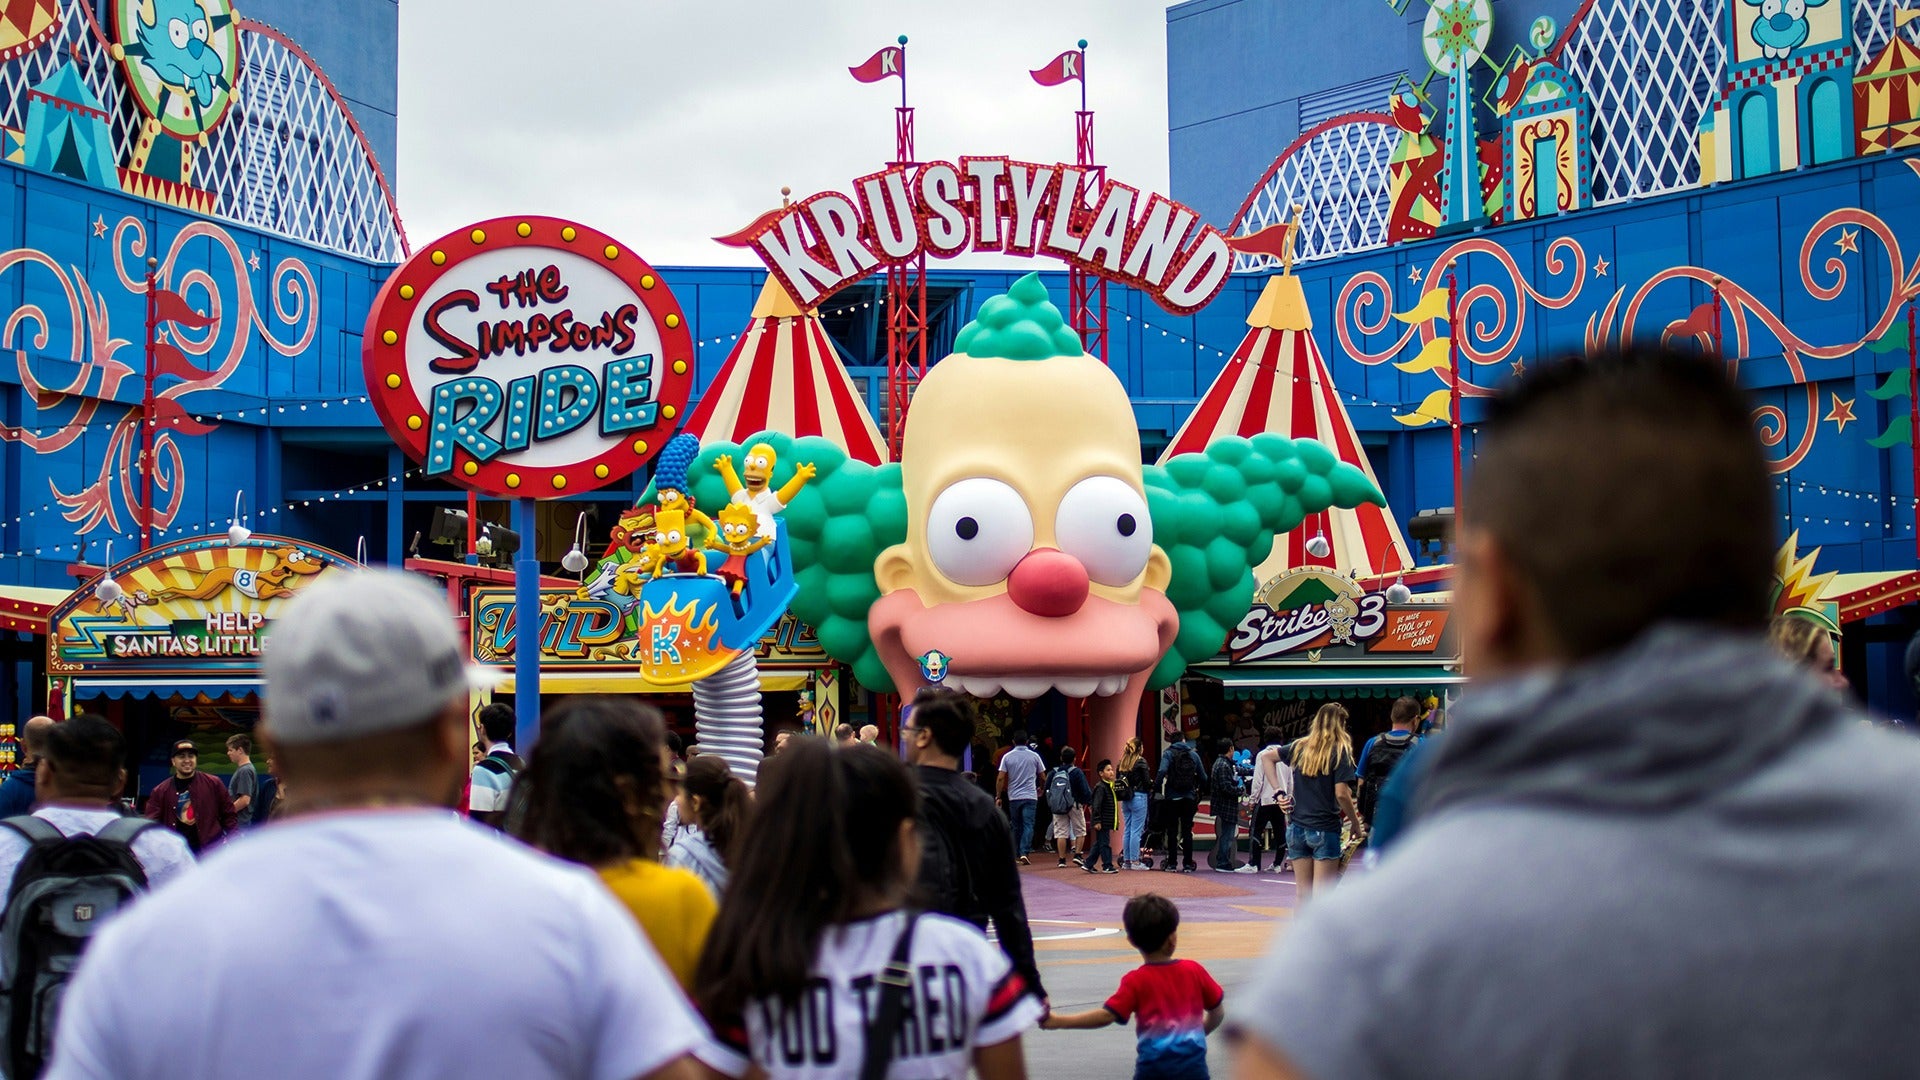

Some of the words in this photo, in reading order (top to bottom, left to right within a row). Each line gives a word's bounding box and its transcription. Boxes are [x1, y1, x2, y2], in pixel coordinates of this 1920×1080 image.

[881, 46, 898, 74] K
[1062, 53, 1078, 79] K
[757, 159, 1233, 309] KRUSTYLAND
[423, 288, 639, 375] SIMPSONS
[425, 354, 660, 478] RIDE
[239, 572, 251, 587] 8
[206, 612, 264, 633] HELP
[1230, 602, 1332, 656] Strike
[1353, 595, 1386, 637] 3
[1397, 616, 1405, 624] BE
[1405, 612, 1421, 621] MADE
[1397, 622, 1415, 634] FOOL
[114, 634, 200, 655] SANTA'S
[652, 624, 682, 665] K
[1402, 631, 1418, 640] STACK
[1411, 634, 1435, 648] CANS!
[1263, 700, 1306, 726] SWING
